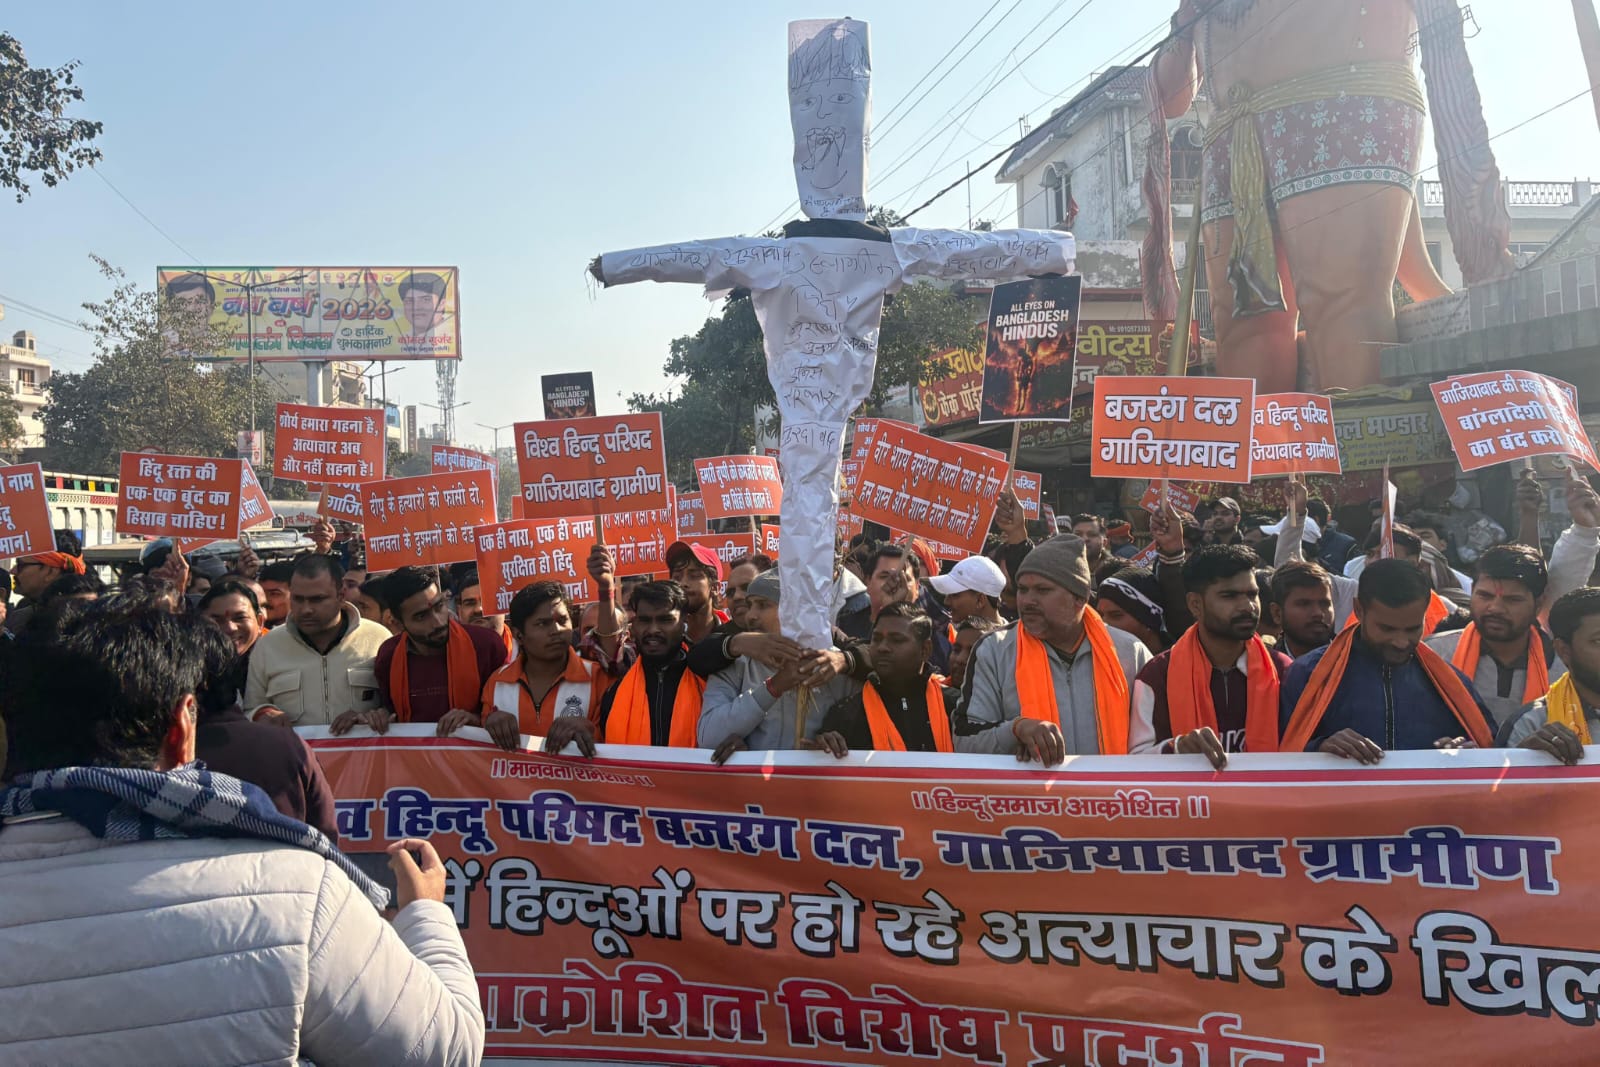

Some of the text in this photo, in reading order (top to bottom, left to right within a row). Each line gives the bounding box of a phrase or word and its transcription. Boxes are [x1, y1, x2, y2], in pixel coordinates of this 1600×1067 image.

[322, 298, 394, 320] 2026
[996, 309, 1069, 327] BANGLADESH
[1010, 300, 1055, 312] ALL EYES ON
[1003, 323, 1058, 341] HINDUS
[1077, 325, 1152, 363] वीट्स
[547, 390, 590, 400] BANGLADESH
[553, 397, 586, 408] HINDUS
[1439, 374, 1519, 404] गाजियाबाद की
[1104, 386, 1188, 422] बजरंग
[1194, 396, 1241, 426] दल
[1267, 401, 1302, 431] हिन्दू
[1301, 400, 1328, 424] परिषद
[1457, 401, 1547, 431] बांग्लादेशी
[279, 411, 378, 436] शौर्य हमारा गहना है,
[293, 438, 361, 455] अत्याचार अब
[524, 423, 652, 464] विश्व हिन्दू परिषद
[1100, 427, 1240, 469] गाजियाबाद
[1252, 438, 1303, 460] जियाबाद
[1305, 437, 1336, 461] ग्रामीण
[1468, 438, 1496, 458] का
[1497, 429, 1528, 450] बंद
[1528, 425, 1564, 446] करो
[139, 458, 218, 484] हिंदू रक्त की
[283, 455, 301, 473] और
[303, 458, 323, 475] नहीं
[326, 462, 356, 476] सहना
[7, 473, 35, 492] नाम
[125, 485, 231, 510] एक-एक बूंद का
[524, 466, 662, 503] गाजियाबाद ग्रामीण
[126, 506, 167, 528] हिसाब
[370, 492, 387, 523] दीपू
[387, 491, 396, 513] के
[398, 487, 425, 515] हत्यारों
[428, 486, 440, 509] को
[443, 482, 466, 507] फांसी
[859, 480, 876, 504] हम
[891, 479, 910, 516] और
[929, 494, 952, 530] दोनों
[947, 504, 971, 535] जानते
[0, 530, 32, 554] मान!
[369, 534, 401, 553] मानवता
[403, 527, 412, 550] के
[414, 523, 442, 556] दुश्मनों
[445, 522, 458, 545] को
[479, 534, 494, 552] एक
[496, 527, 506, 550] ही
[508, 528, 534, 549] नारा,
[536, 525, 555, 544] एक
[556, 519, 569, 541] ही
[572, 519, 594, 538] नाम
[501, 554, 536, 586] सुरक्षित
[539, 550, 551, 573] हो
[553, 547, 577, 577] हिंदू
[991, 795, 1062, 817] समाज
[1065, 789, 1179, 821] आक्रोशित
[381, 786, 498, 856] हिन्दू
[496, 789, 645, 847] परिषद
[646, 803, 801, 861] बजरंग
[804, 818, 924, 881] दल,
[933, 826, 1288, 879] गाजियाबाद
[1292, 825, 1562, 896] ग्रामीण
[697, 888, 785, 949] पर
[789, 879, 865, 957] हो
[873, 887, 966, 966] रहे
[977, 909, 1292, 991] अत्याचार
[1295, 903, 1399, 997] के
[1409, 909, 1600, 1027] खिल
[775, 975, 1009, 1066] विरोध
